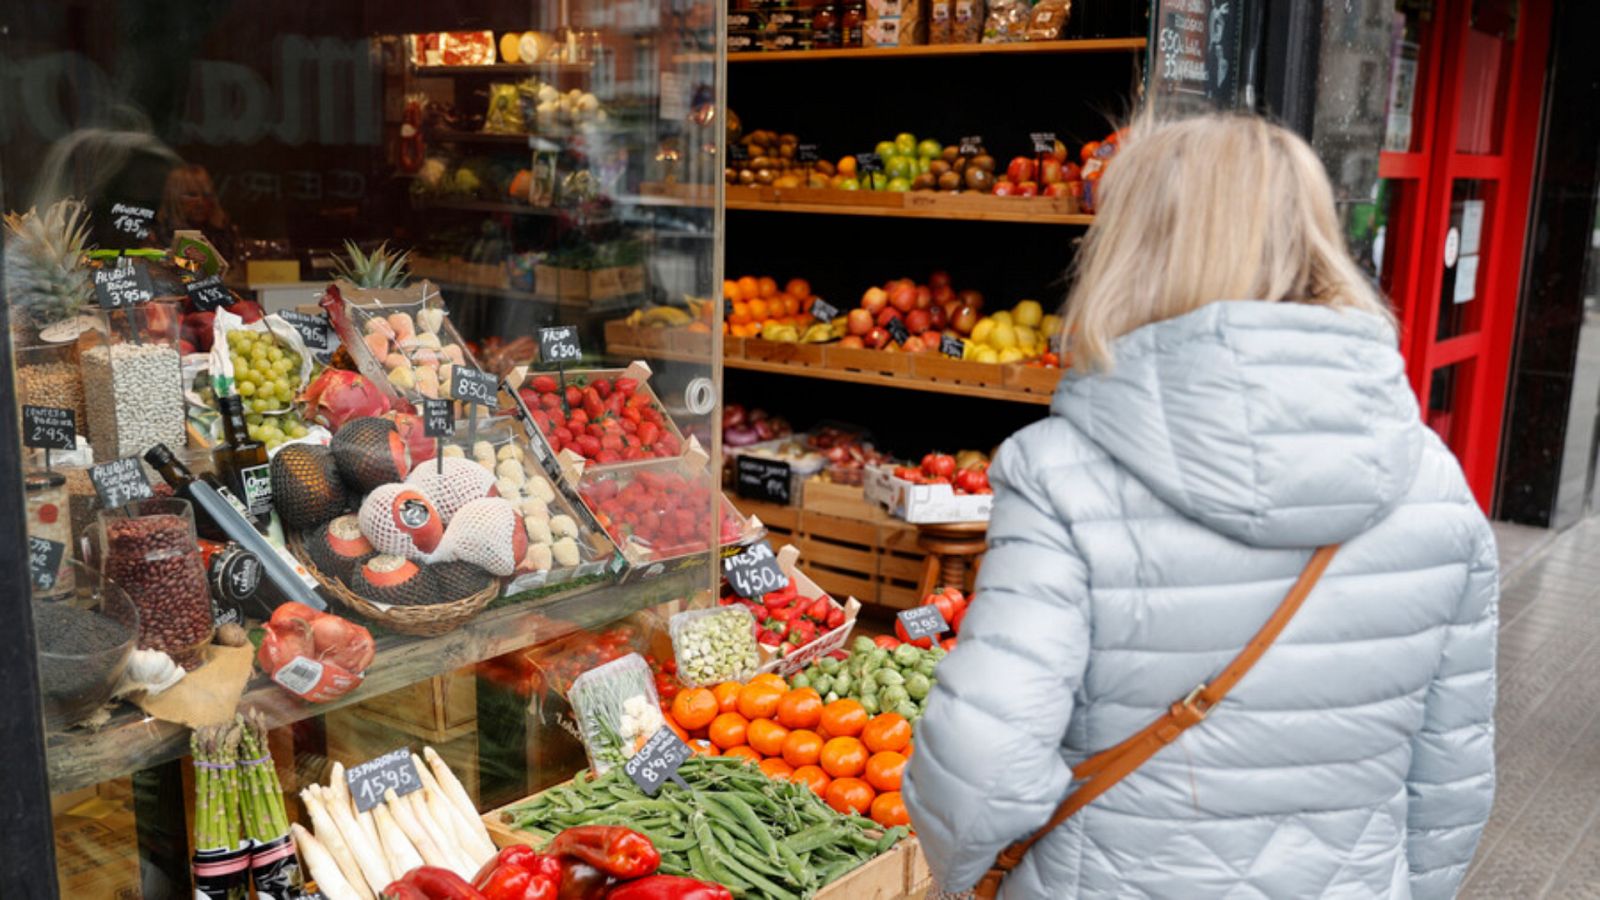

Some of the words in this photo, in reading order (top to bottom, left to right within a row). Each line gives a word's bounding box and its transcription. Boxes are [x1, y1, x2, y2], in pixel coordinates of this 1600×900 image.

[110, 289, 140, 306] 3'95
[550, 341, 576, 358] 6'50
[31, 426, 65, 442] 2'95
[735, 566, 776, 595] 4'50
[641, 748, 675, 783] 8'95
